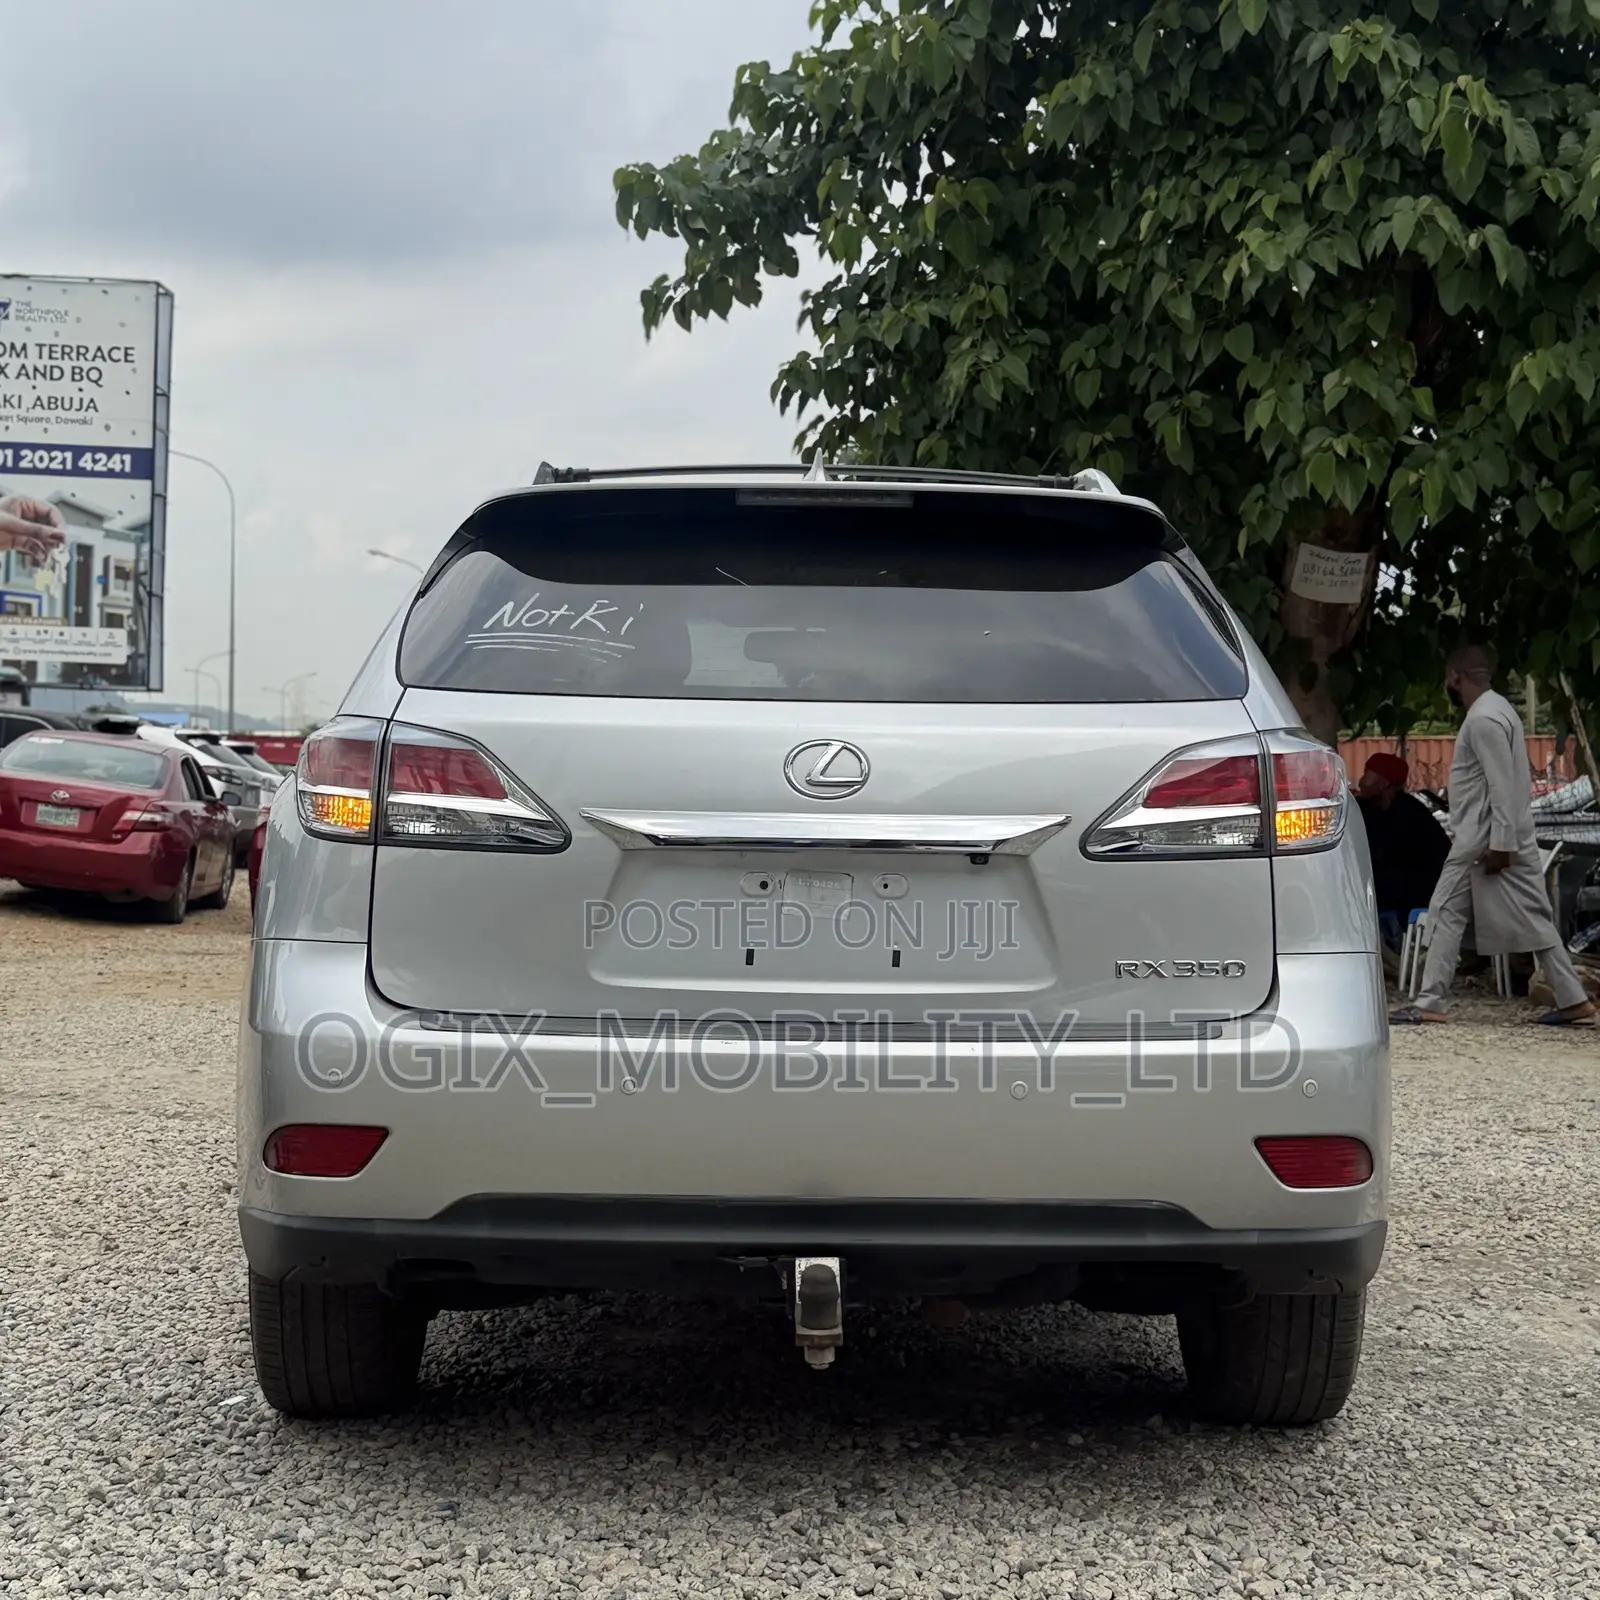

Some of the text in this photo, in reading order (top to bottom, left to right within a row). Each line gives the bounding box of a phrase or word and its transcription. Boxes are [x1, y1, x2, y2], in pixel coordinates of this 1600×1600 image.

[35, 343, 135, 363] TERRACE
[15, 363, 64, 381] AND
[71, 365, 104, 388] BQ
[0, 393, 22, 409] KI
[18, 448, 73, 470] 2021
[78, 452, 132, 473] 4241
[1115, 959, 1247, 979] RX 350
